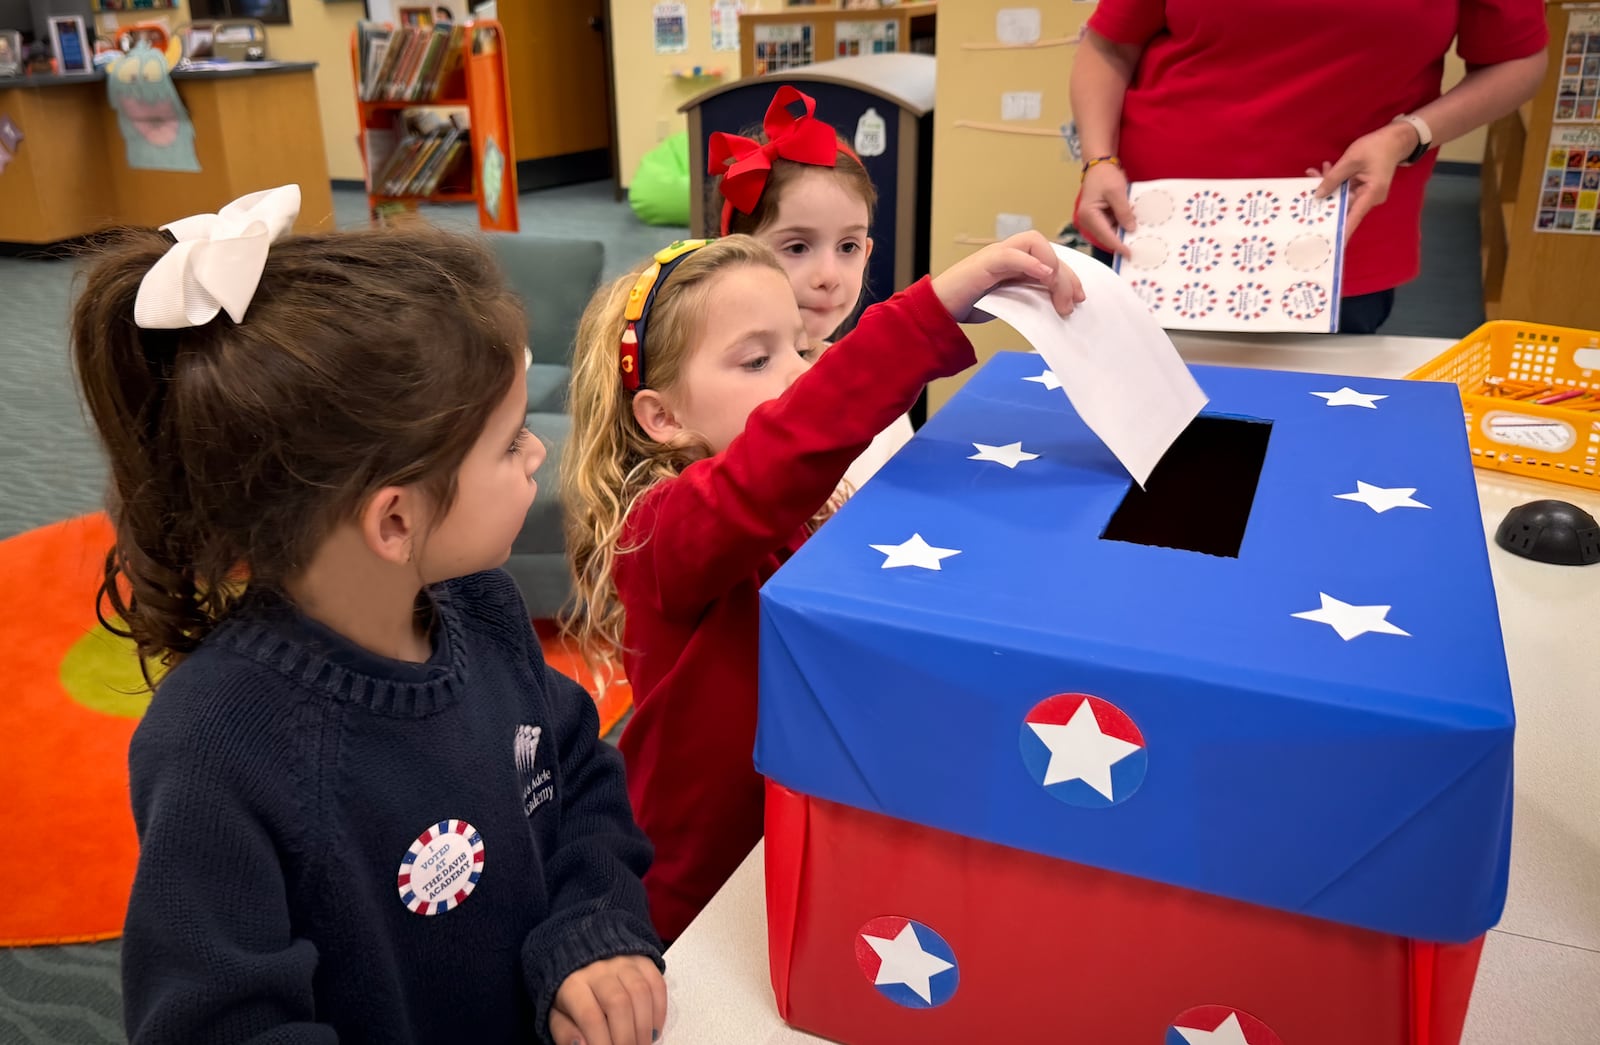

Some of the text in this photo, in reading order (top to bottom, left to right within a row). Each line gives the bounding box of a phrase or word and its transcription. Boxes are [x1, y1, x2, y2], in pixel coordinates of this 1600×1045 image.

[531, 769, 552, 790] Adele
[421, 844, 450, 870] VOTED
[435, 858, 447, 872] AT
[422, 852, 467, 893] THE DAVIS
[429, 860, 471, 900] ACADEMY
